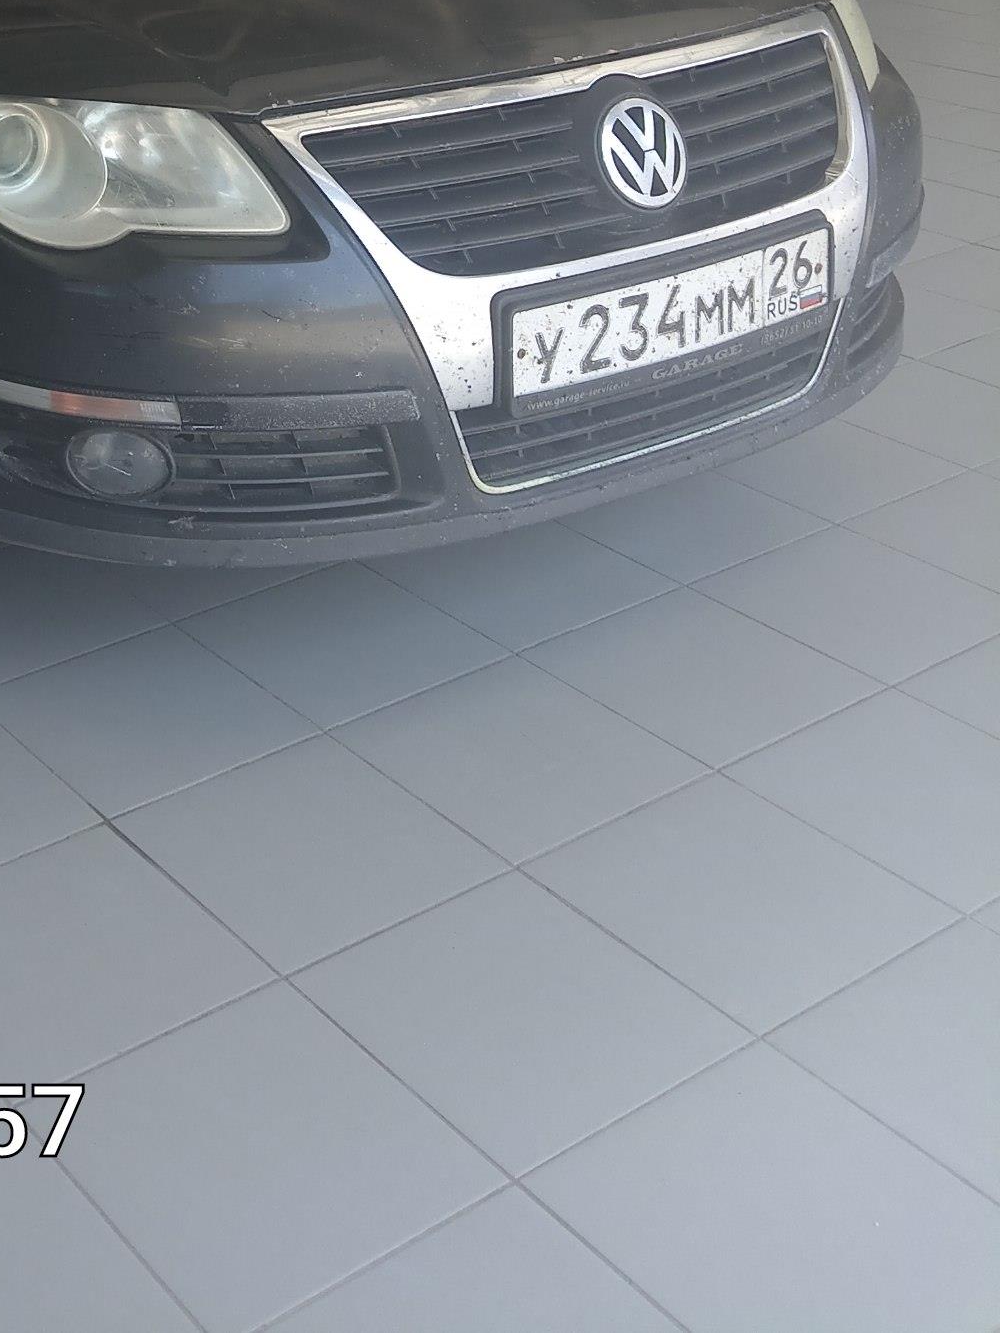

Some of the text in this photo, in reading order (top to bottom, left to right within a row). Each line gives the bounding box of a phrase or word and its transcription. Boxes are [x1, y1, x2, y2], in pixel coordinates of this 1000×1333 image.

[768, 239, 813, 297] 26
[766, 294, 799, 320] RUS
[651, 343, 744, 381] GARAGE
